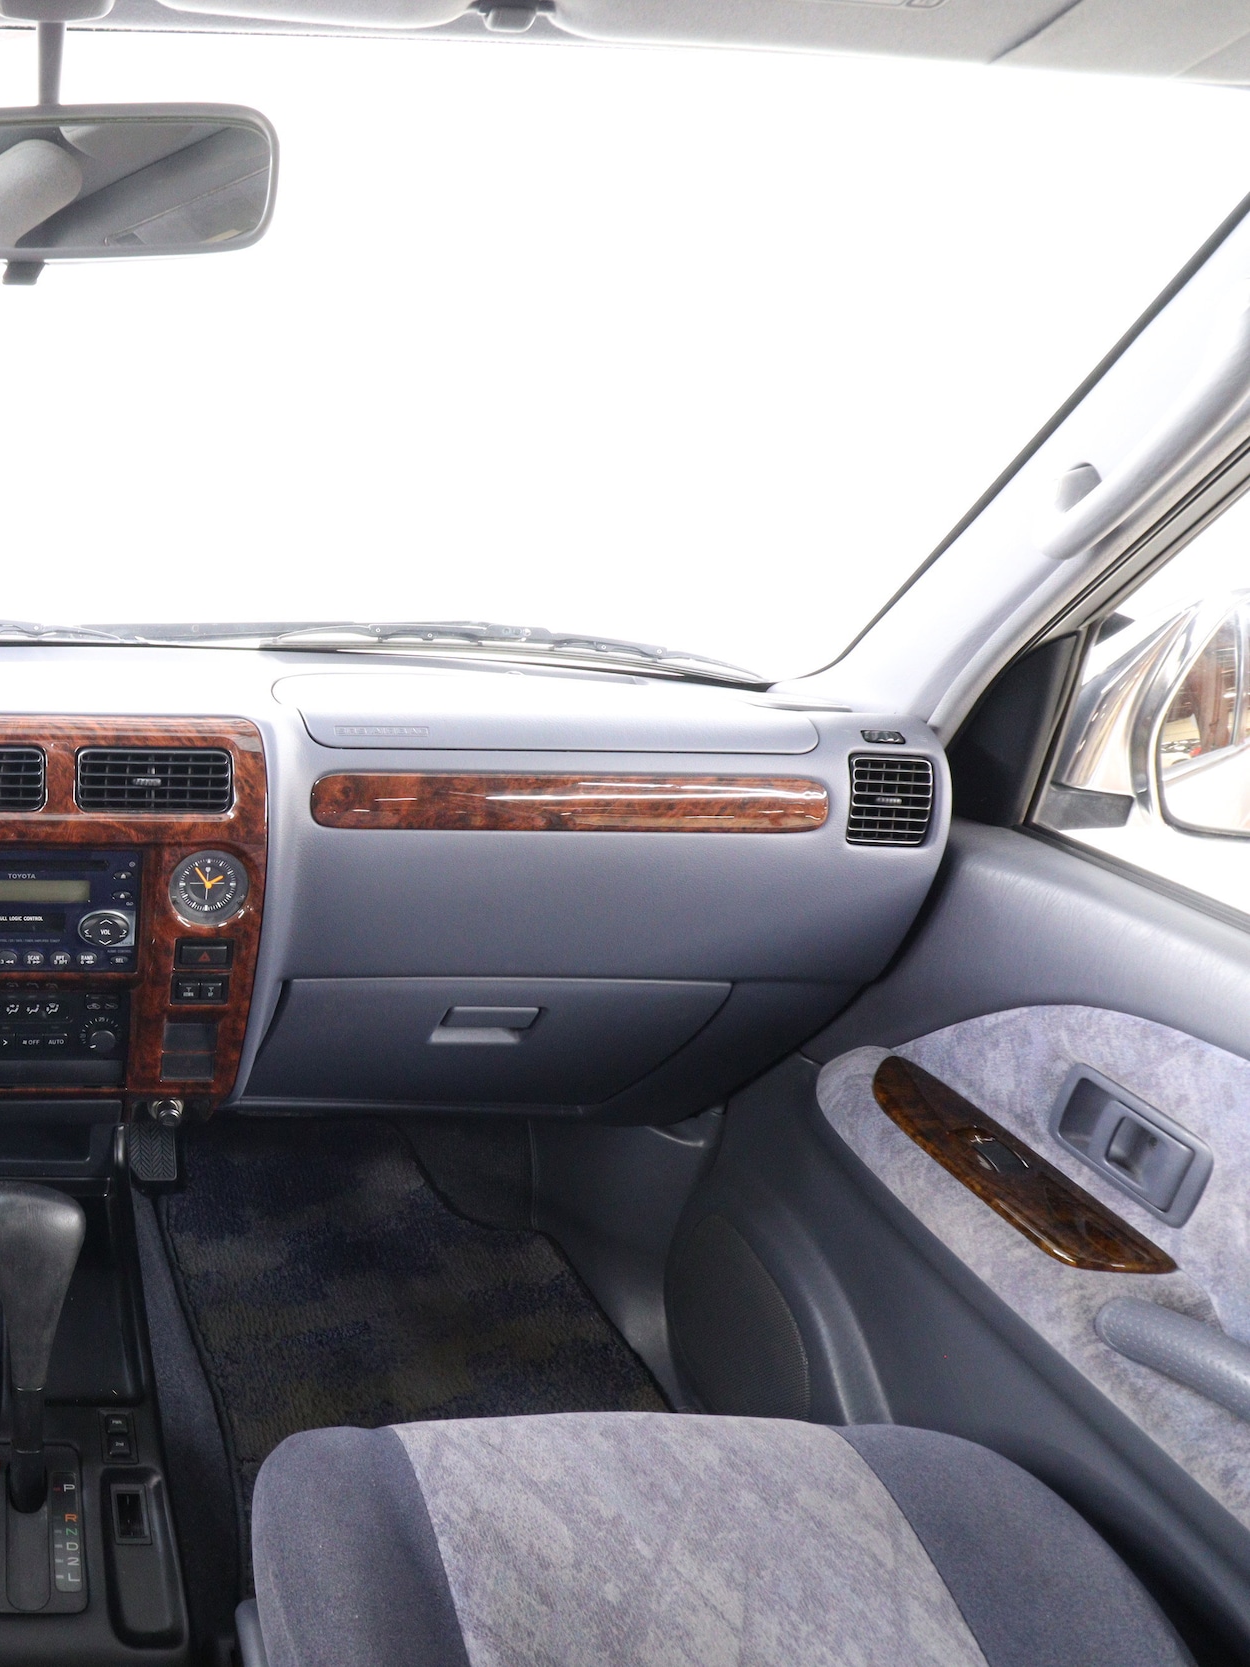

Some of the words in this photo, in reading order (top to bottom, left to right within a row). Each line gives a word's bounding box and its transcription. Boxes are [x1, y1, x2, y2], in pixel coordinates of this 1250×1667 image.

[63, 1484, 76, 1492] P
[64, 1513, 78, 1522] R
[65, 1528, 78, 1536] N
[66, 1542, 79, 1551] D
[67, 1557, 80, 1566] 2
[68, 1573, 81, 1582] L
